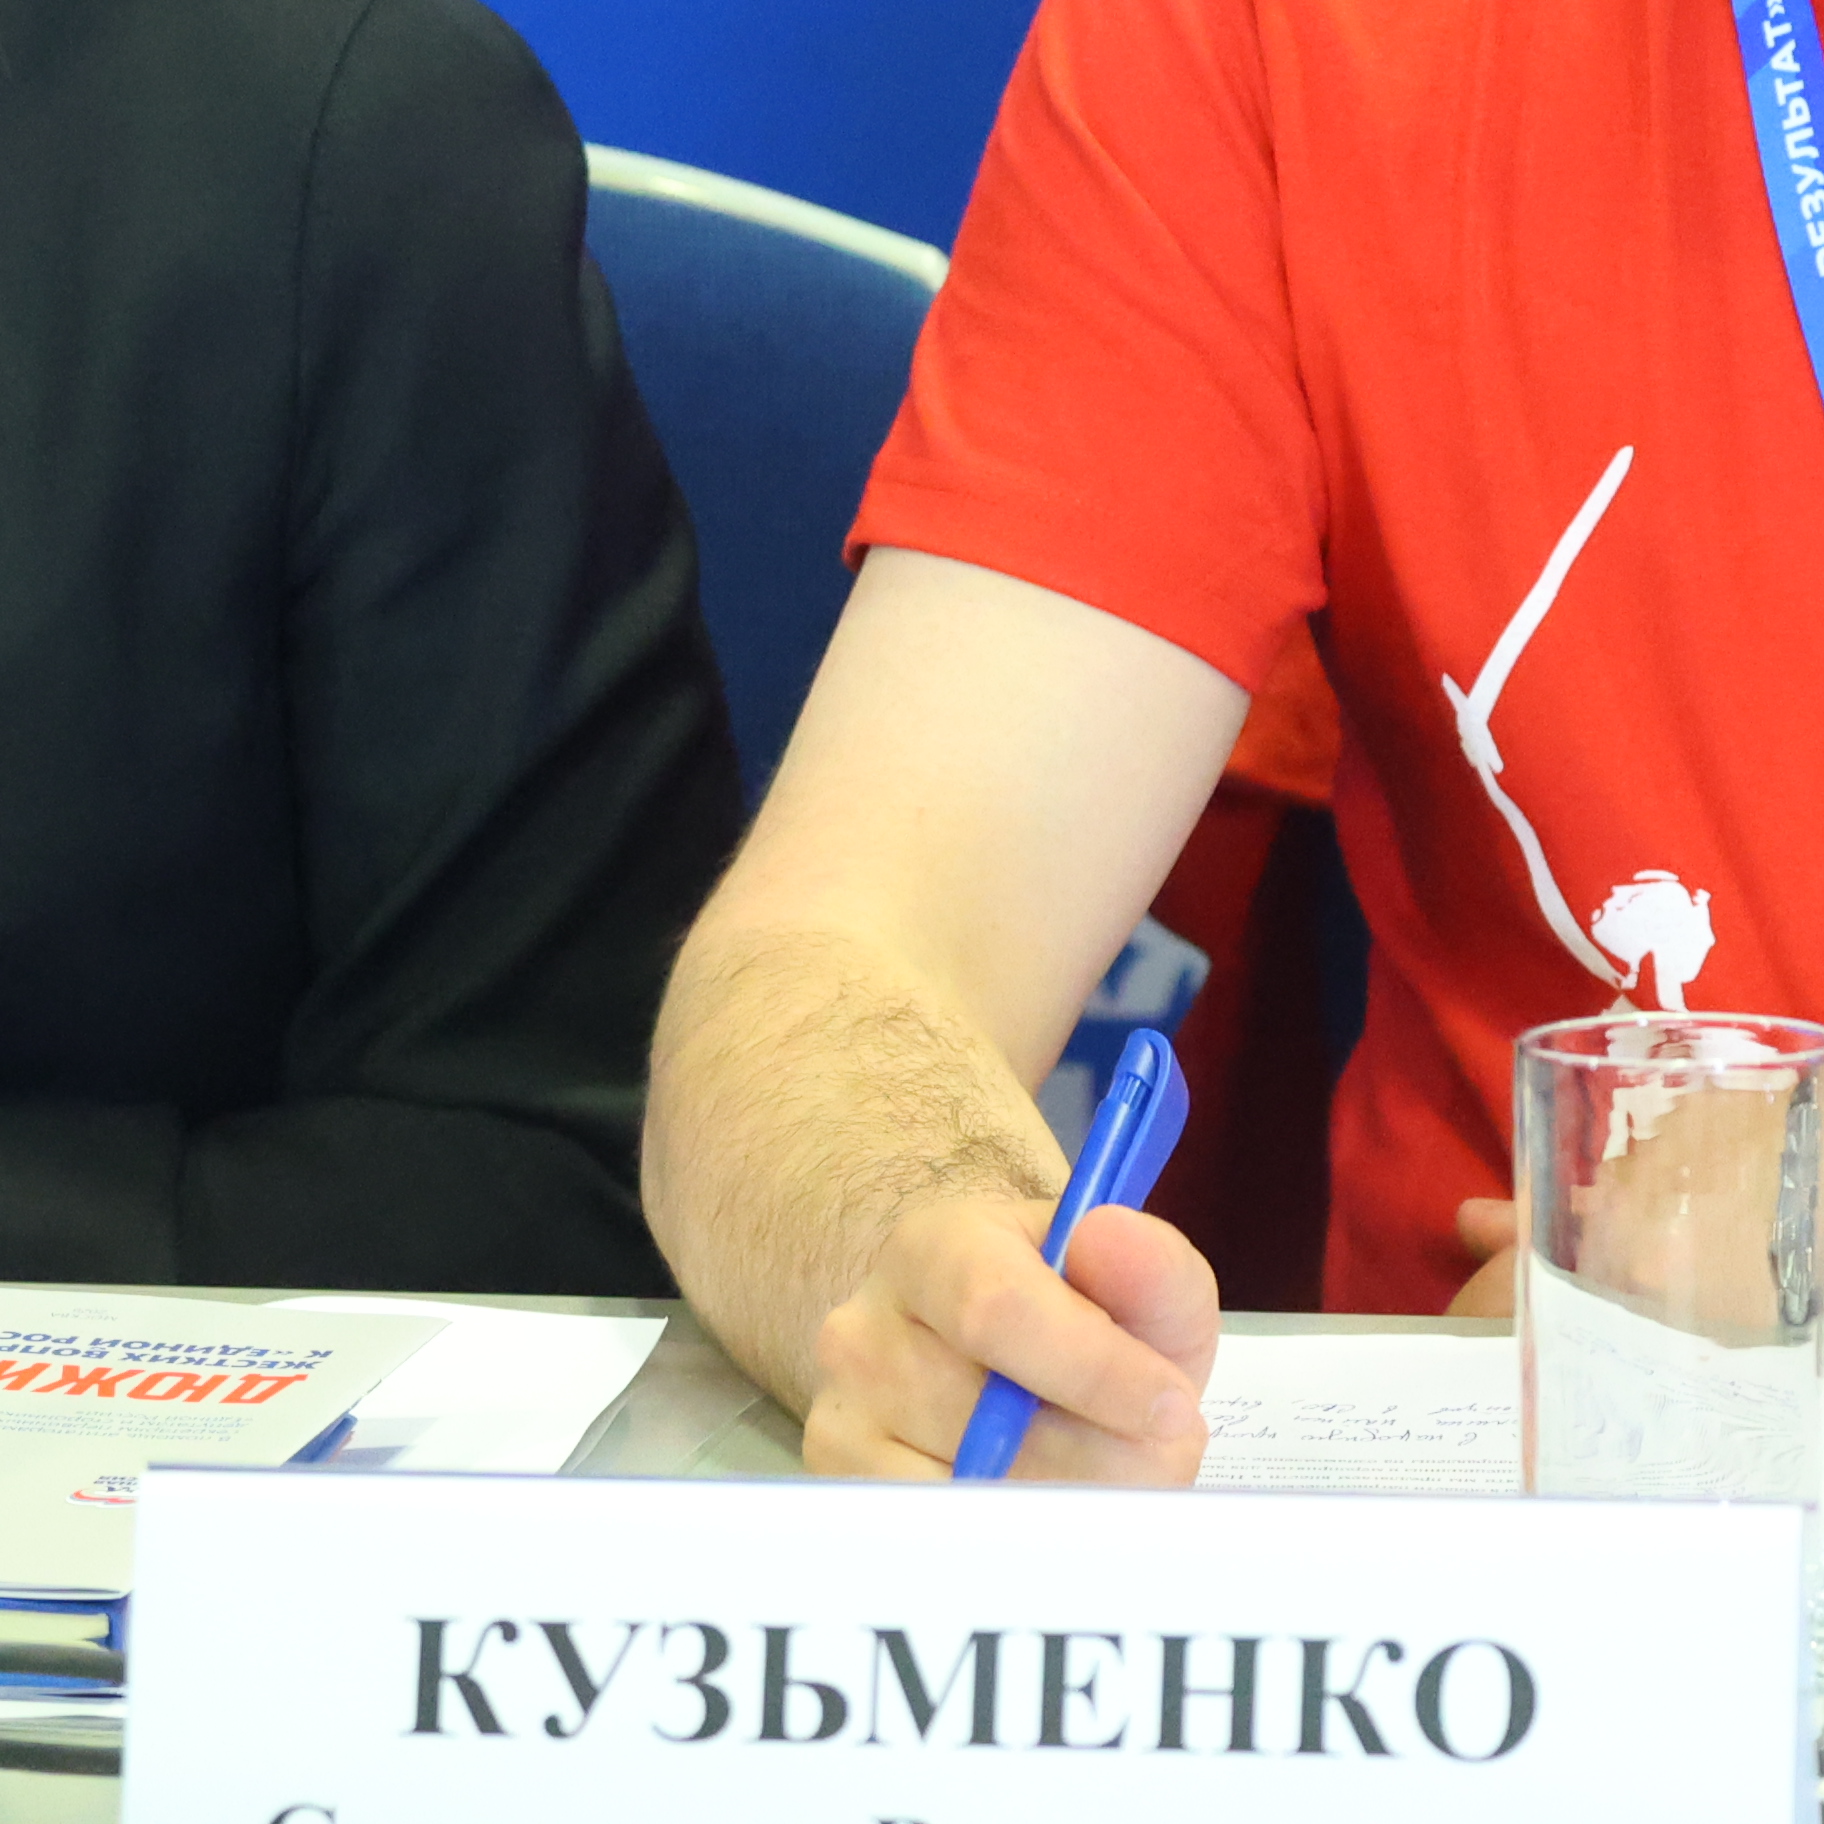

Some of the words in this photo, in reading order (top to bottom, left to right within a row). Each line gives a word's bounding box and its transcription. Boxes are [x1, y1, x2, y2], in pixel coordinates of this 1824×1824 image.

[90, 1335, 296, 1360] «ЕДИНОЙ
[314, 1348, 336, 1360] К
[117, 1351, 324, 1371] ЖЕСТКИХ
[398, 1615, 1542, 1764] КУЗЬМЕНКО
